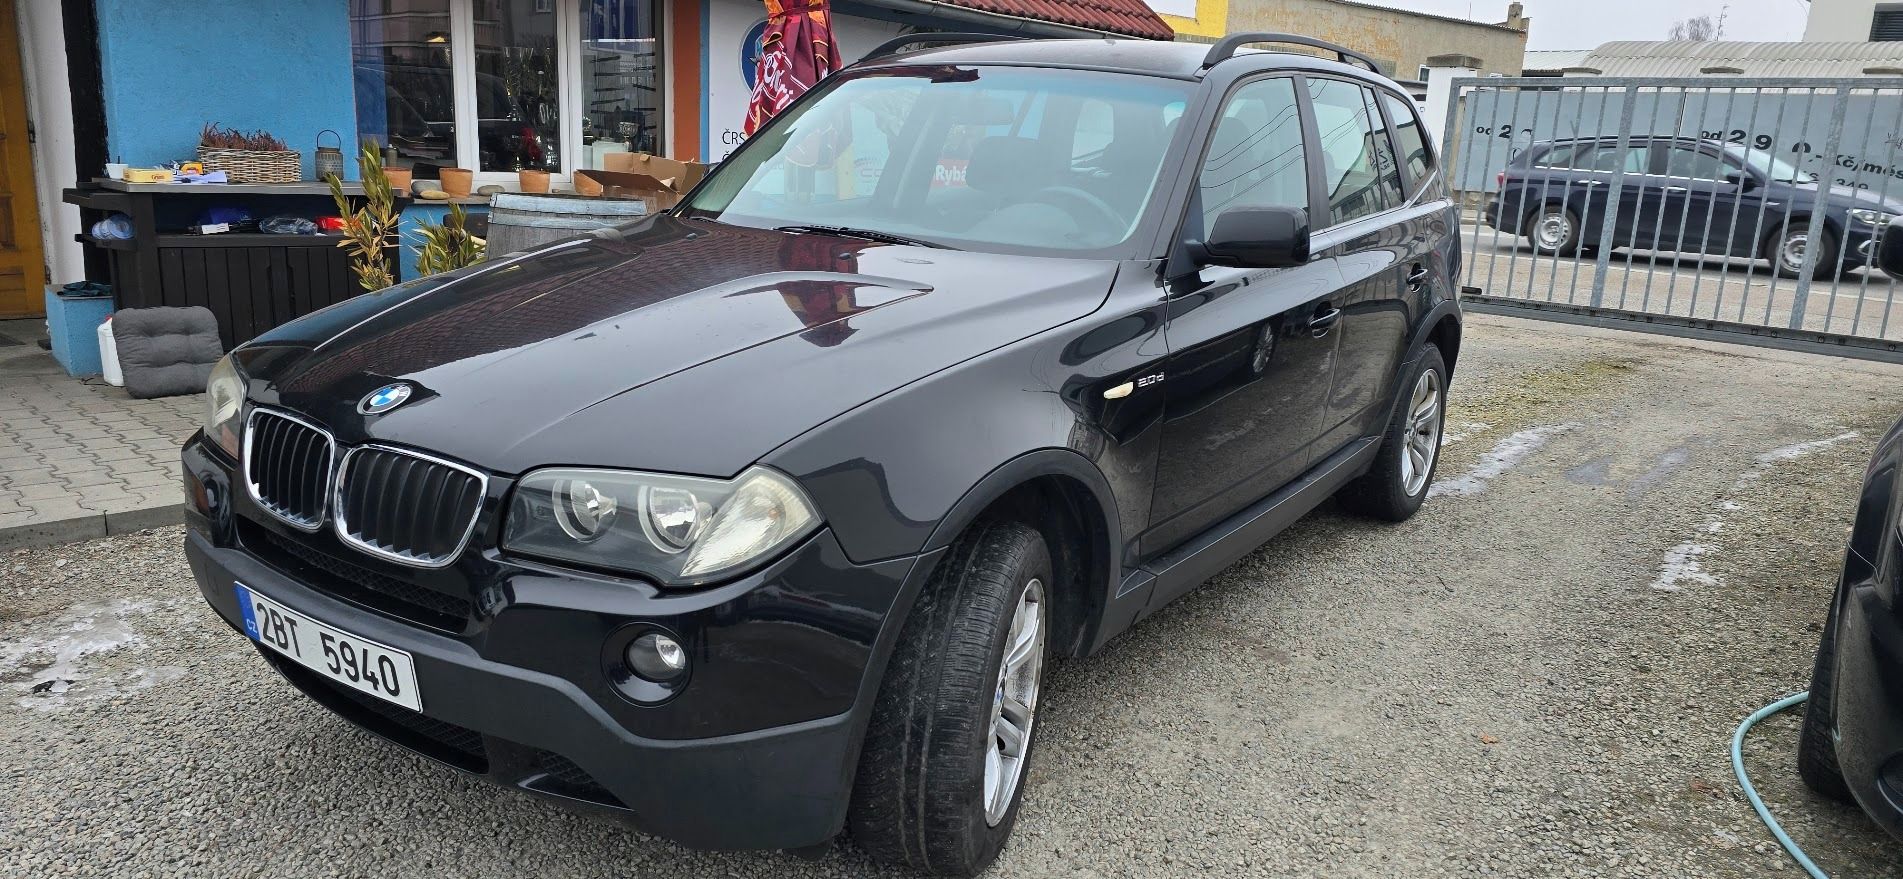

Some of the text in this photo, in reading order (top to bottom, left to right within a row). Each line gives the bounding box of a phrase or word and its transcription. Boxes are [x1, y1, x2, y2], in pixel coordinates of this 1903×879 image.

[246, 618, 258, 634] CZ
[257, 603, 401, 697] 2BT 5940
